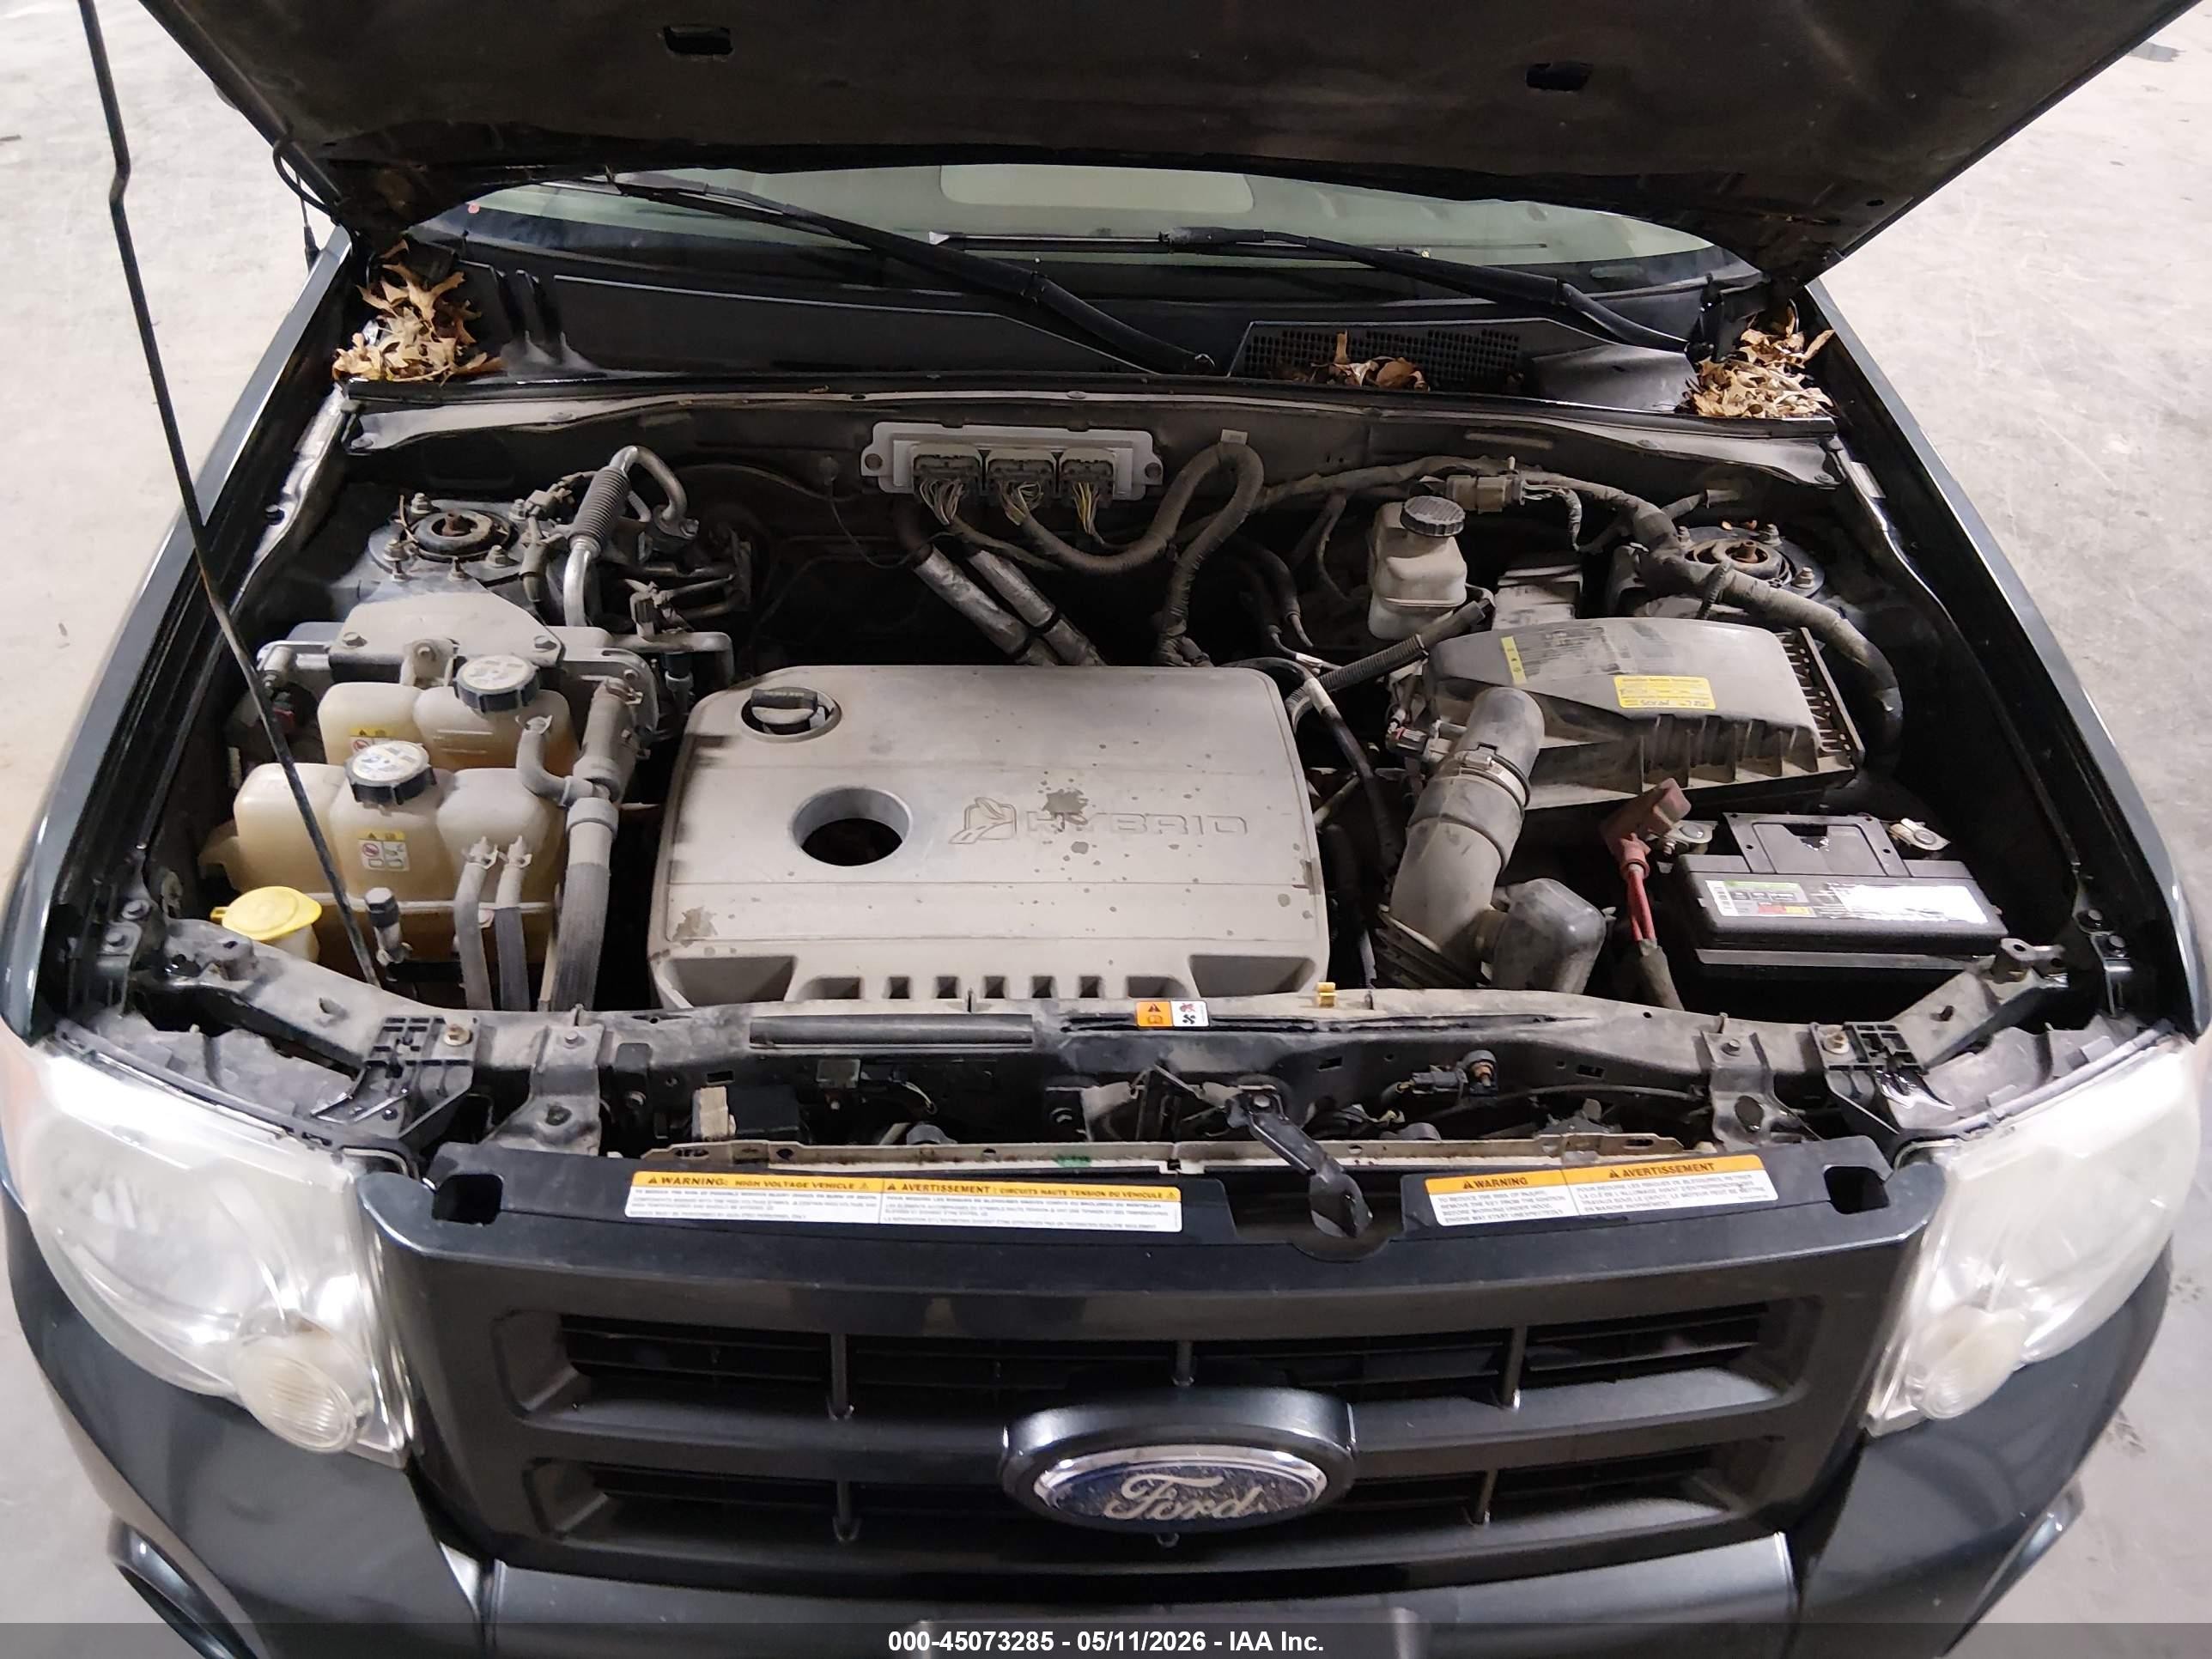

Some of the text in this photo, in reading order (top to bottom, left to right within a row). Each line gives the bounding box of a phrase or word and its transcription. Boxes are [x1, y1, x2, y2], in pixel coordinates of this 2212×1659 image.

[1622, 1162, 1715, 1178] AVERTISSEMENT
[902, 1184, 989, 1194] AVERTISSEMENT
[1474, 1176, 1528, 1189] WARNING
[1103, 1474, 1267, 1520] Ford
